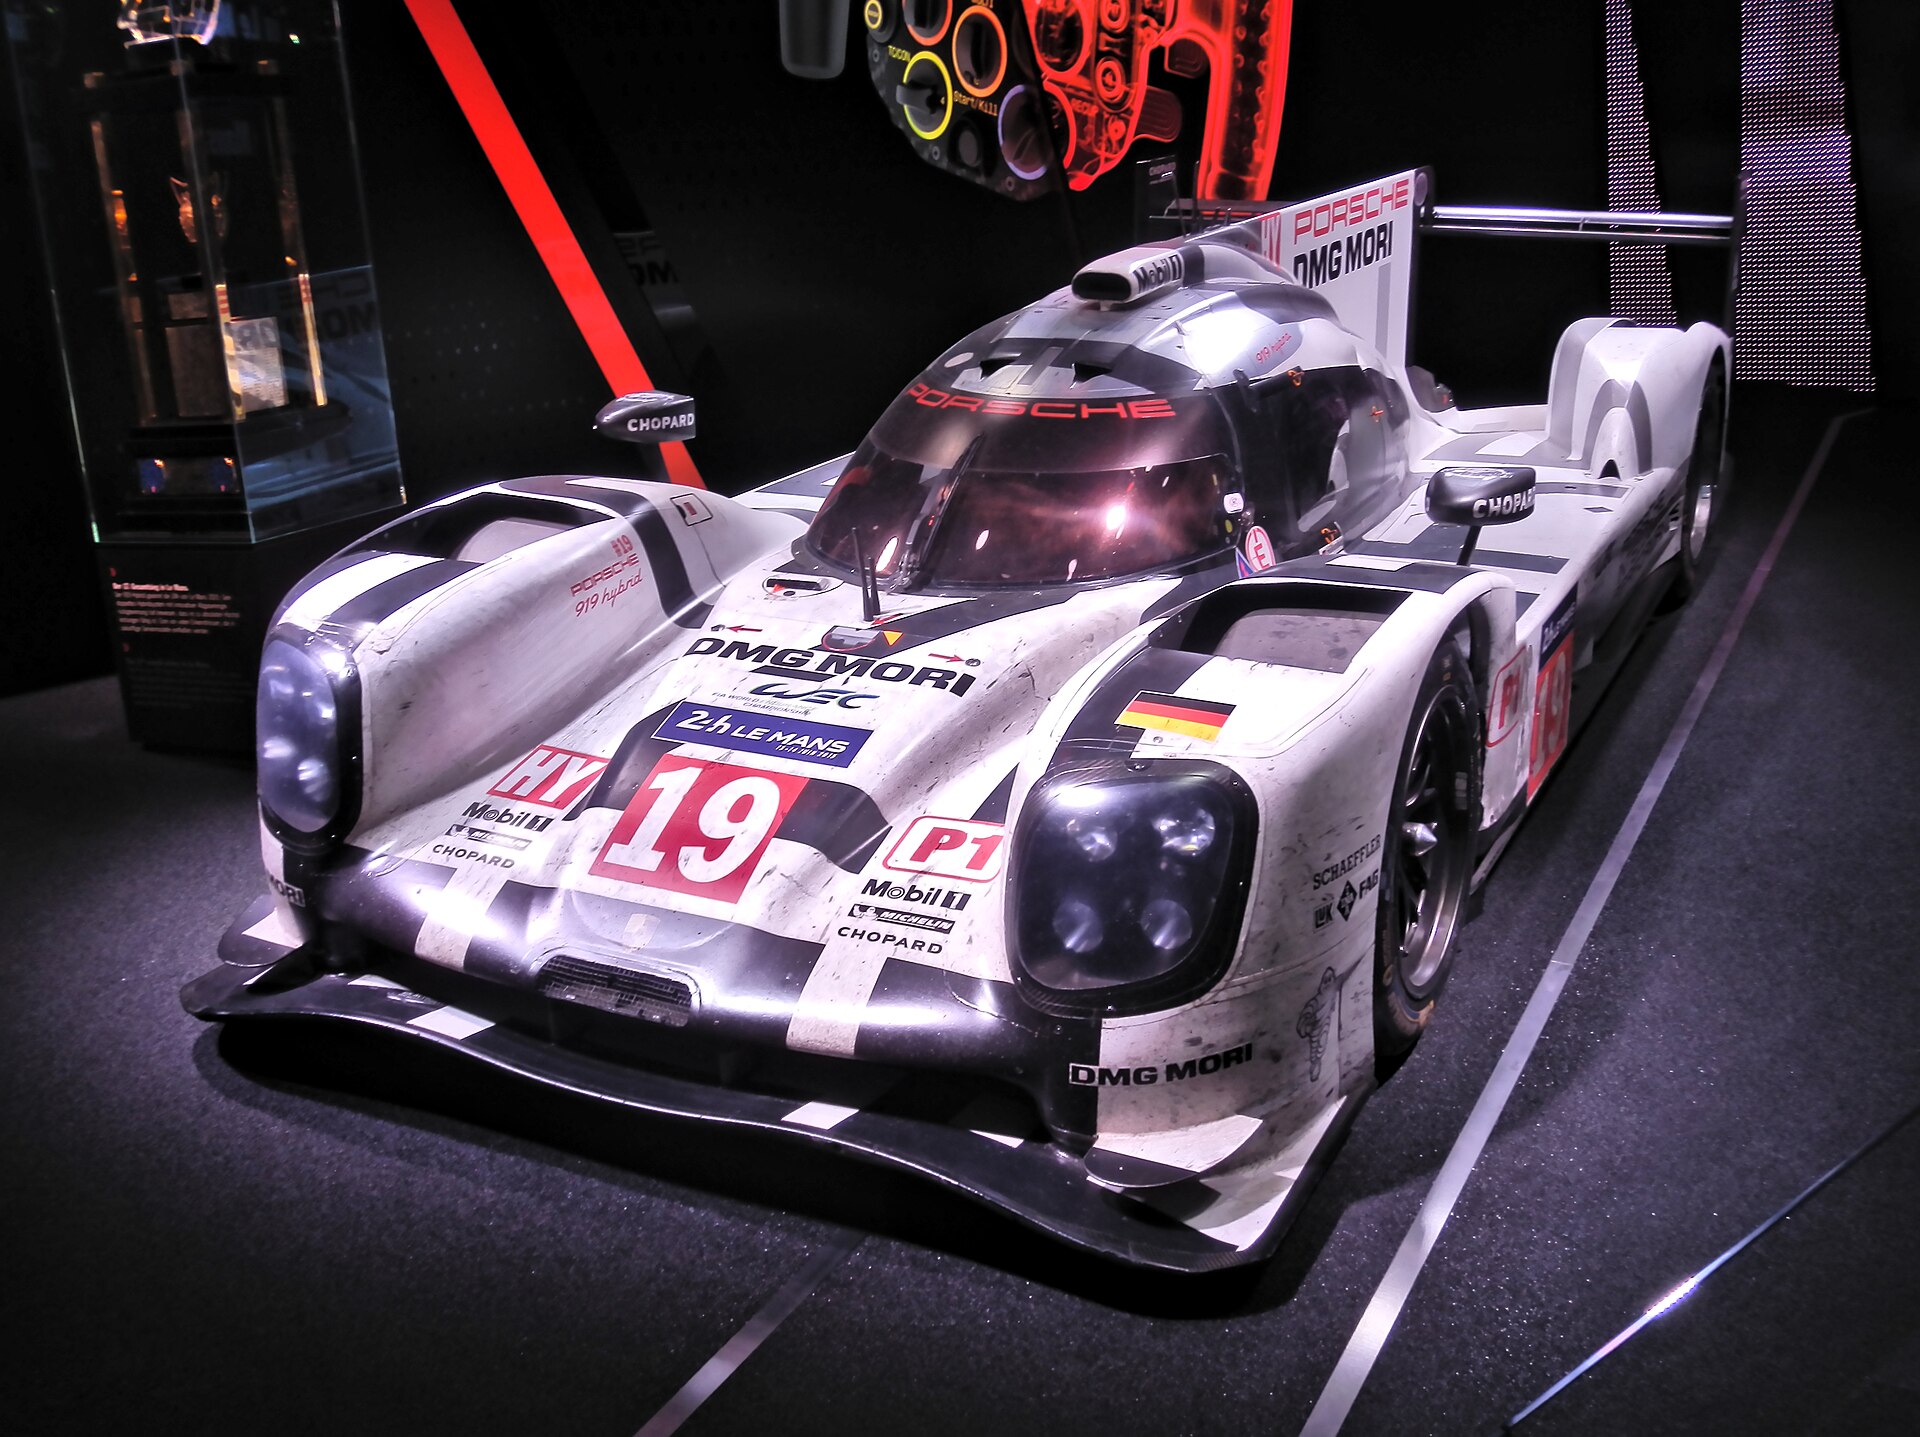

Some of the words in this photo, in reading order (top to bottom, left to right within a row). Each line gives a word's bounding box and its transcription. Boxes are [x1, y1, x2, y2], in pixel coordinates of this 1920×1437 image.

[1294, 179, 1409, 245] PORSCHE
[1293, 240, 1342, 289] DMG
[1345, 220, 1393, 275] MORI
[1133, 257, 1170, 294] Mobil
[907, 383, 1176, 418] PORSCHE
[627, 413, 695, 432] CHOPARD
[570, 553, 640, 597] PORSCHE
[575, 592, 598, 617] 919
[601, 568, 643, 607] hybrid
[683, 637, 814, 668] DMG
[815, 654, 977, 698] MORI
[750, 683, 880, 709] WEC
[730, 725, 771, 741] LE
[766, 730, 850, 754] MANS
[494, 749, 607, 804] HY
[461, 802, 531, 827] Mobil
[603, 766, 780, 883] 19
[433, 844, 515, 868] CHOPARD
[909, 827, 1004, 871] P1
[1313, 834, 1381, 890] SCHAEFFLER
[270, 874, 304, 905] ORI
[861, 879, 942, 905] Mobil
[1359, 868, 1379, 899] FAG
[879, 911, 953, 930] MICHELIN
[837, 926, 943, 954] CHOPARD
[1071, 1065, 1158, 1086] DMG
[1166, 1043, 1253, 1083] MORI
